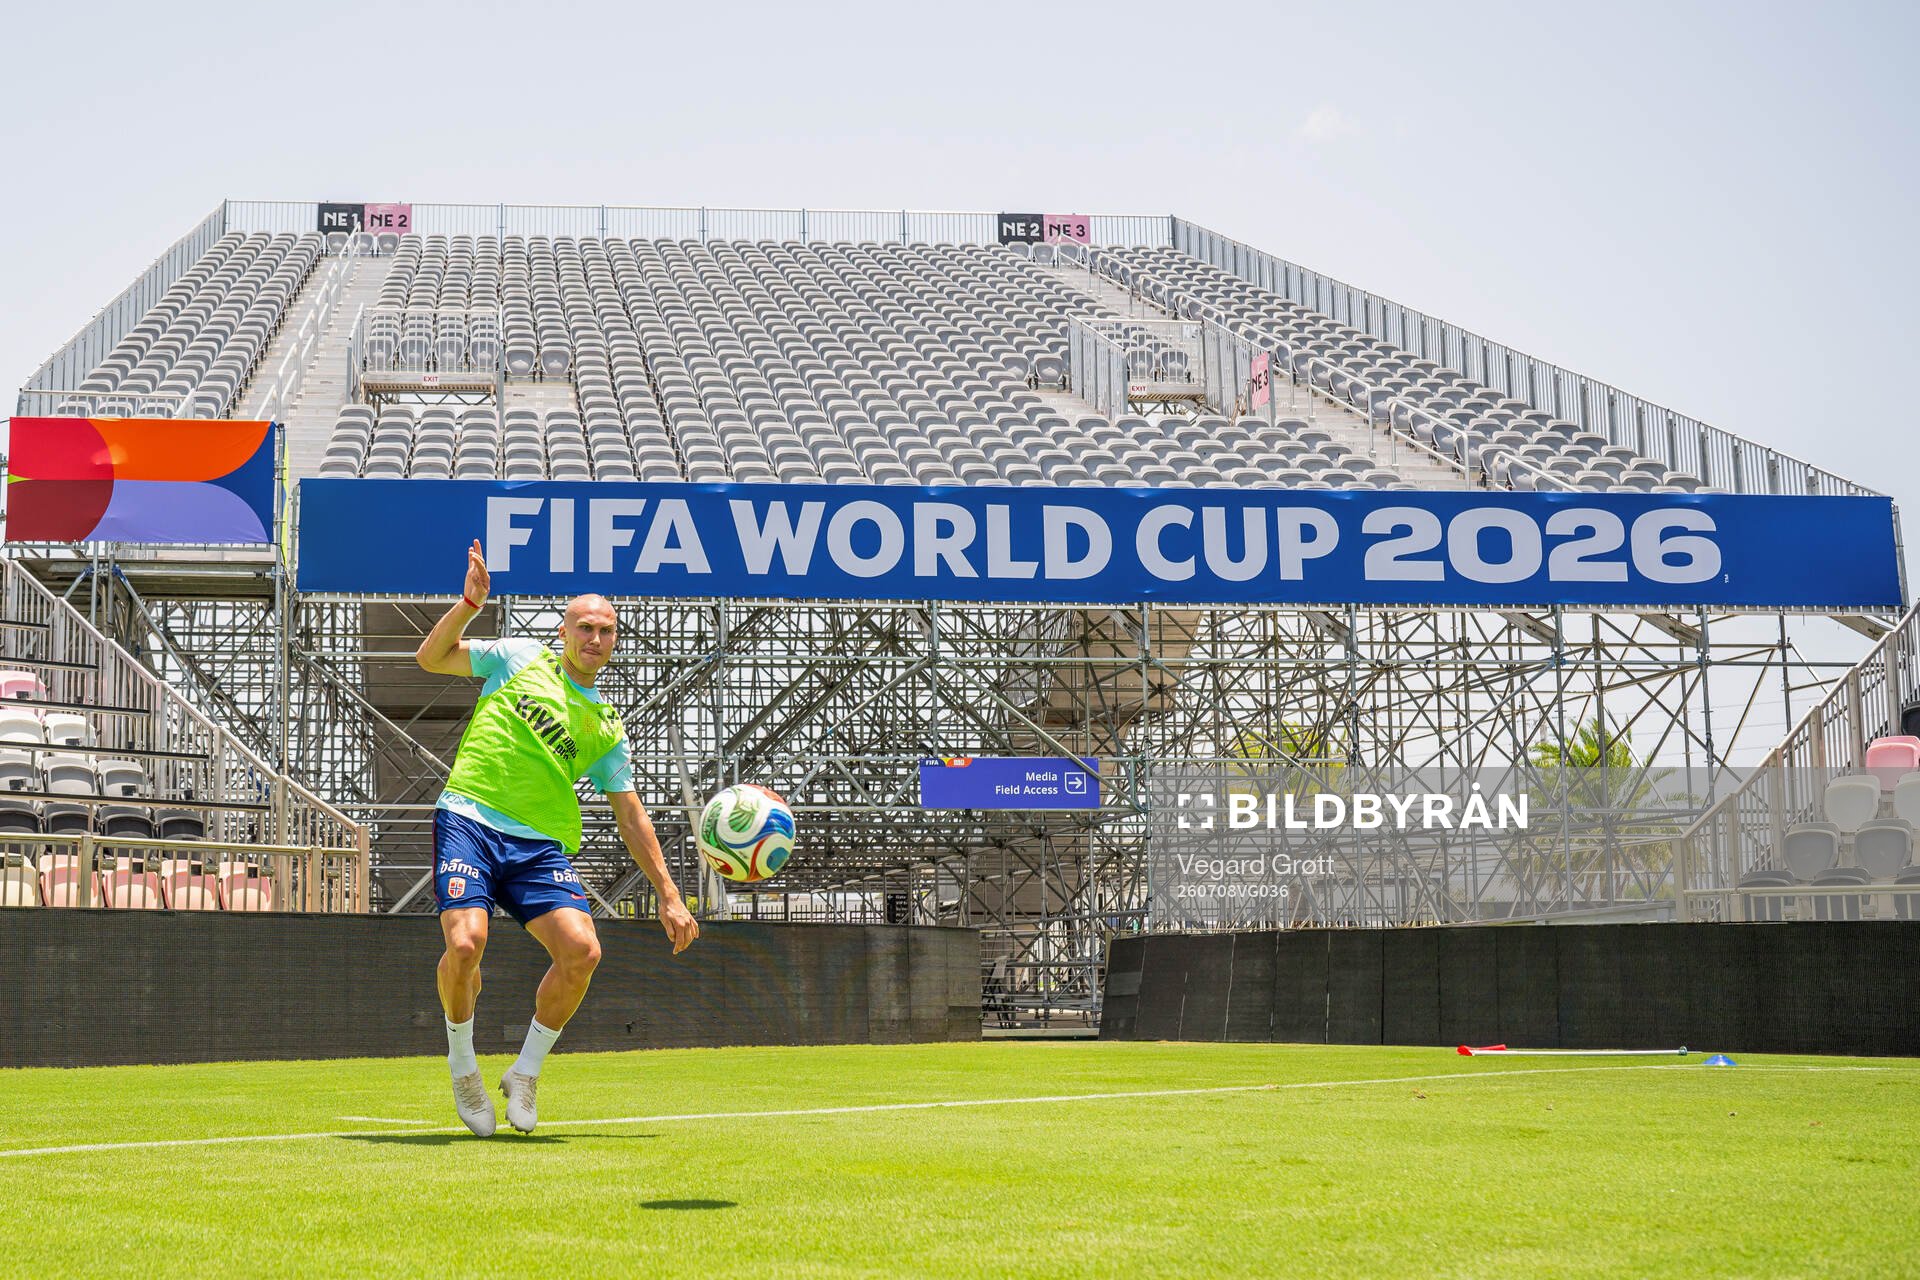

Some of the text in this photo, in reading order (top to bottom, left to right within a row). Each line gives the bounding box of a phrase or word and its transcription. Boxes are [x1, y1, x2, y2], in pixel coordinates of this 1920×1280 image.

[323, 212, 359, 227] NE 1
[370, 214, 408, 227] NE 2
[1002, 222, 1040, 237] NE 2
[1049, 224, 1086, 237] NE 3
[1263, 369, 1269, 386] 3
[486, 497, 1722, 584] FIFA WORLD CUP 2026
[515, 695, 566, 747] KIWI
[1025, 771, 1058, 782] Media
[995, 784, 1059, 795] Field Access
